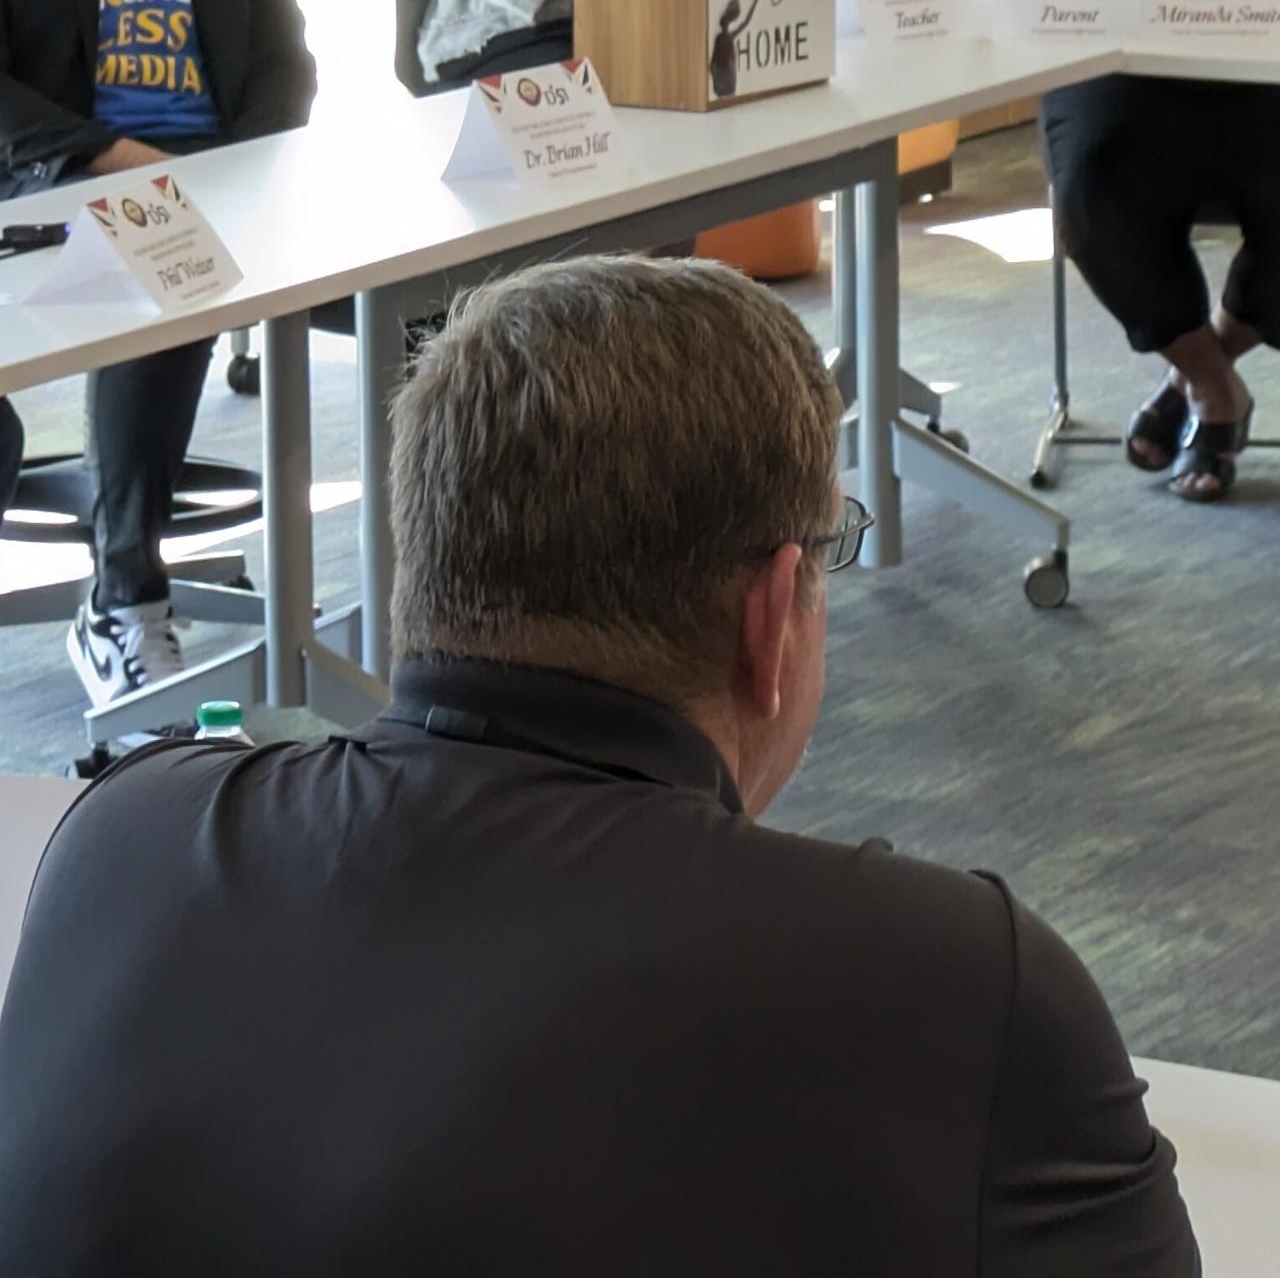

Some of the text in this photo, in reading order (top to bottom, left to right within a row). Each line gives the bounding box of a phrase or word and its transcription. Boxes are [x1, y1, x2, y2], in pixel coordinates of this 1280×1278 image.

[894, 7, 942, 30] Teacher
[1040, 4, 1100, 24] Parent
[1150, 4, 1233, 24] Miranda
[737, 21, 810, 73] HOME
[95, 54, 203, 96] MEDIA
